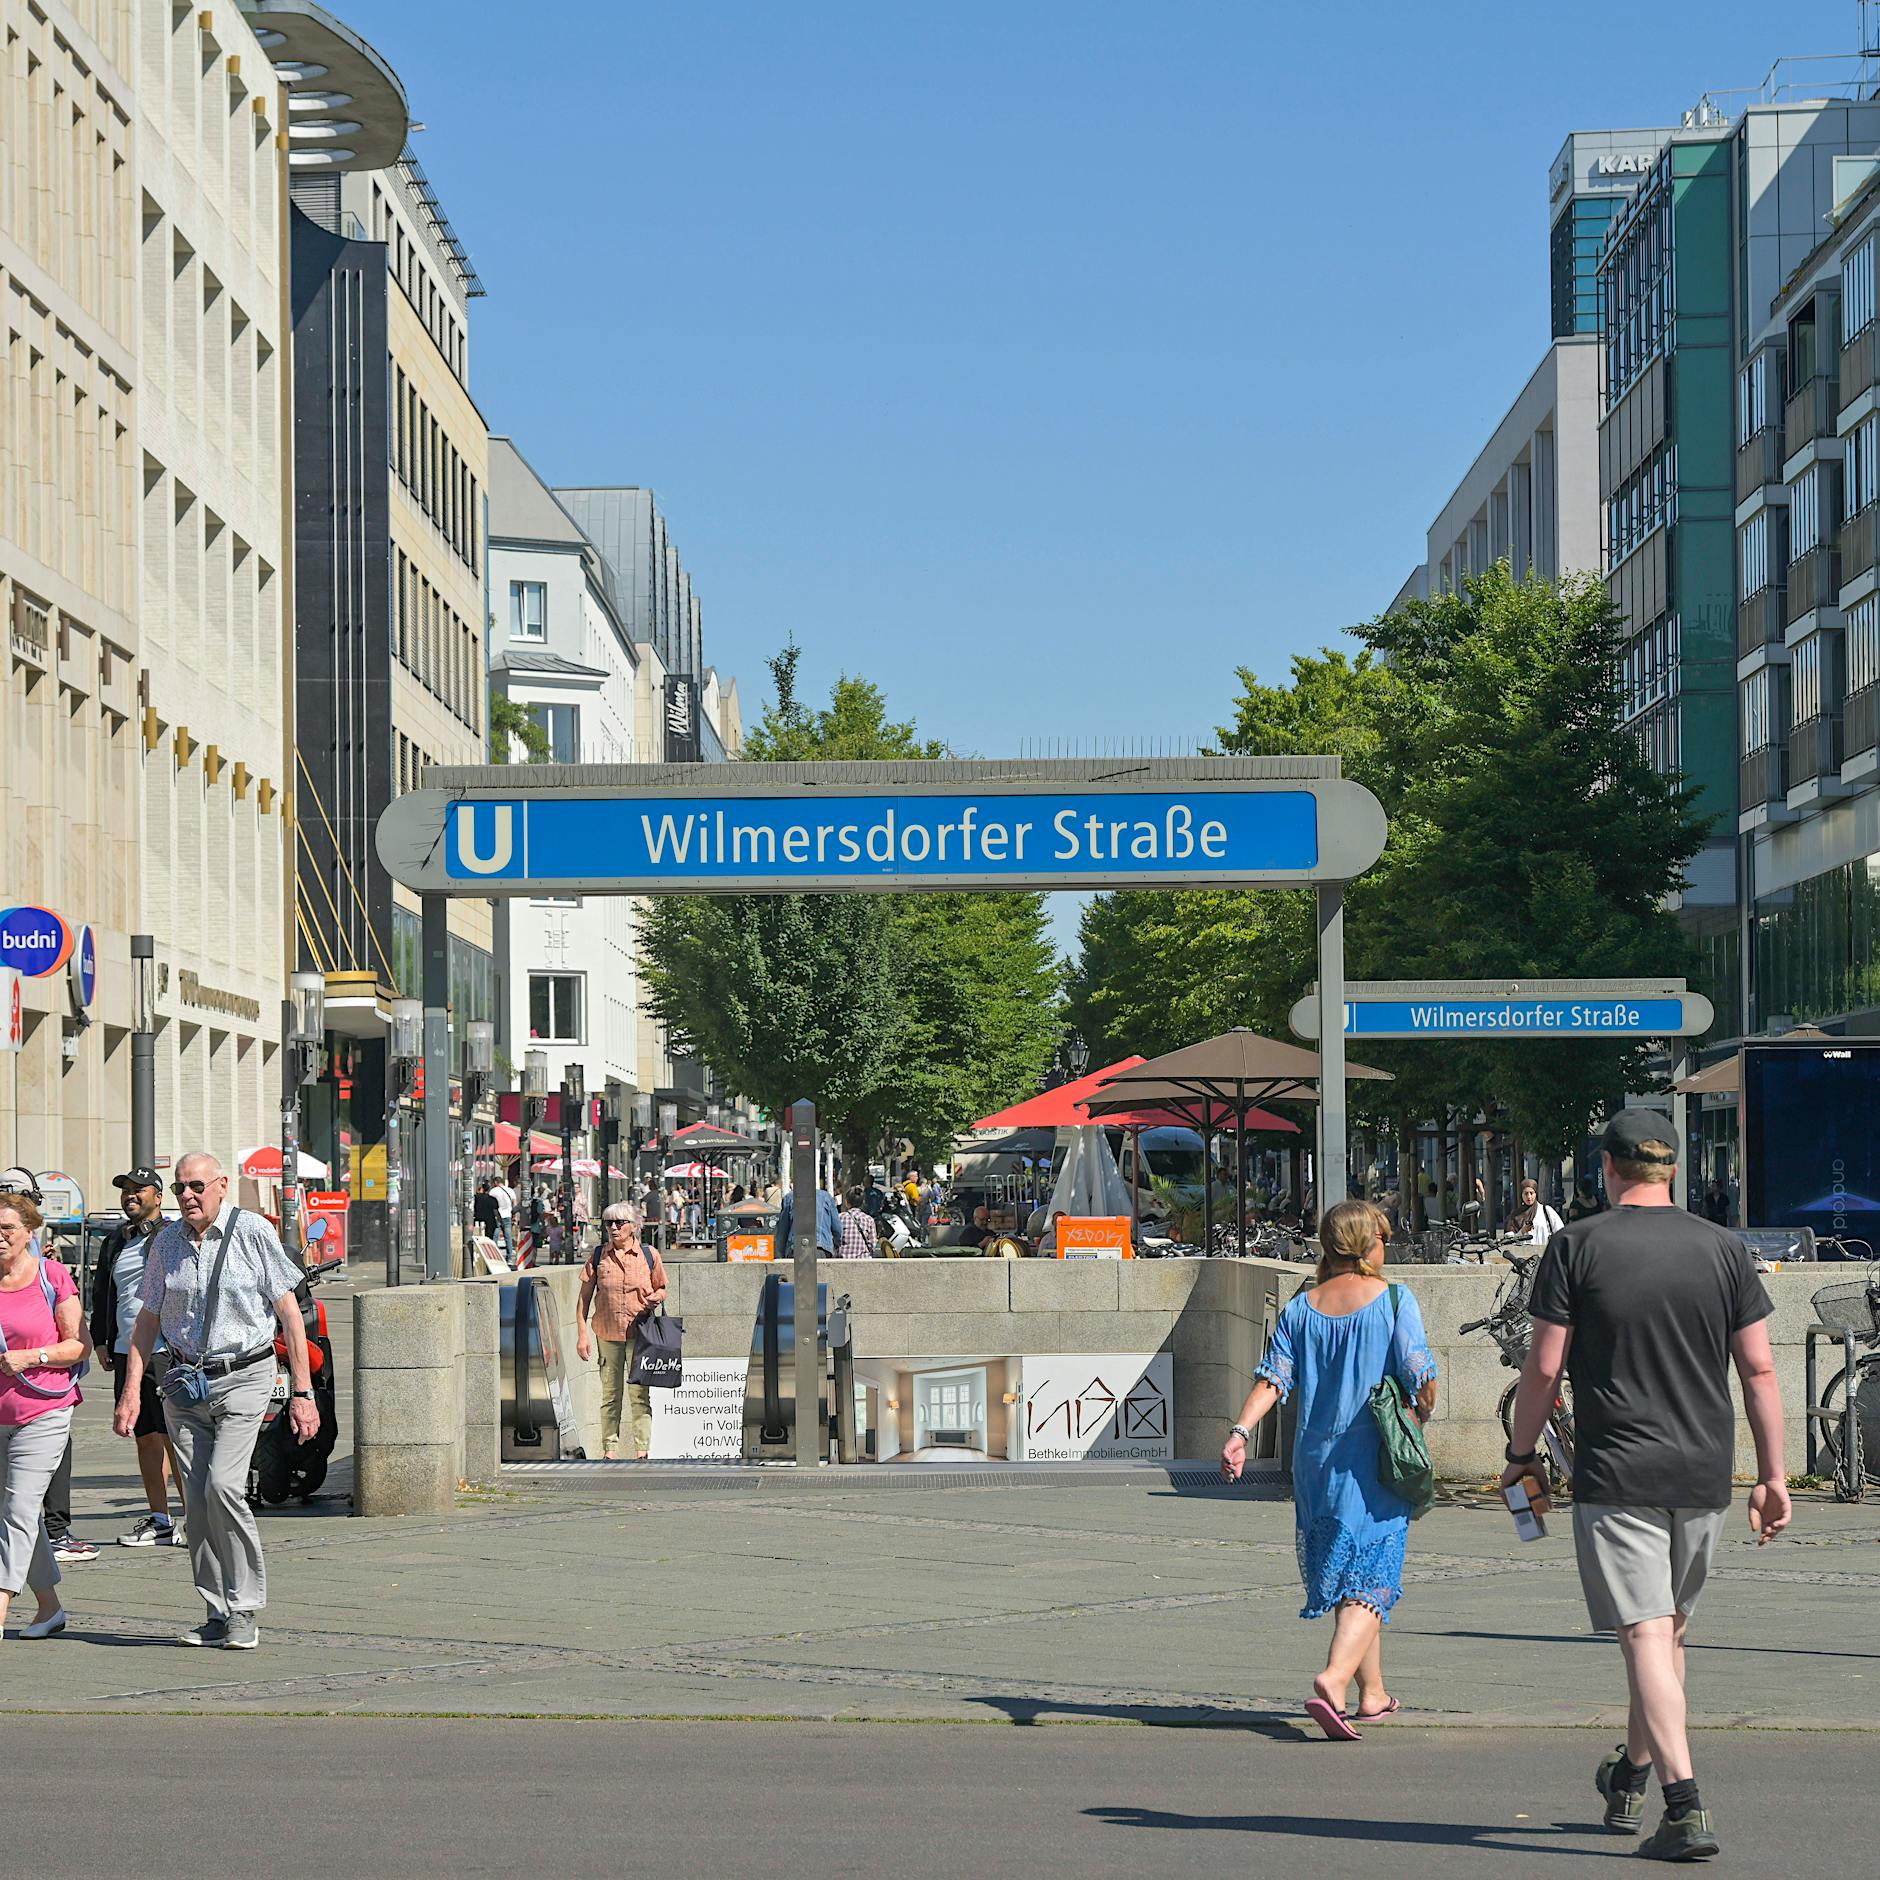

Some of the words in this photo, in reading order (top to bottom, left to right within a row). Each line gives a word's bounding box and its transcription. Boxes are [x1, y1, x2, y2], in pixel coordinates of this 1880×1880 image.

[457, 805, 513, 874] U
[641, 806, 1033, 864] Wilmersdorfer
[1053, 804, 1228, 860] Straße
[2, 929, 57, 949] budni
[1410, 1004, 1564, 1028] Wilmersdorfer
[1571, 1003, 1640, 1026] Straße
[1832, 1051, 1852, 1059] Wall
[1832, 1158, 1848, 1230] android
[640, 1356, 682, 1371] KaDeWe
[703, 1419, 713, 1431] in
